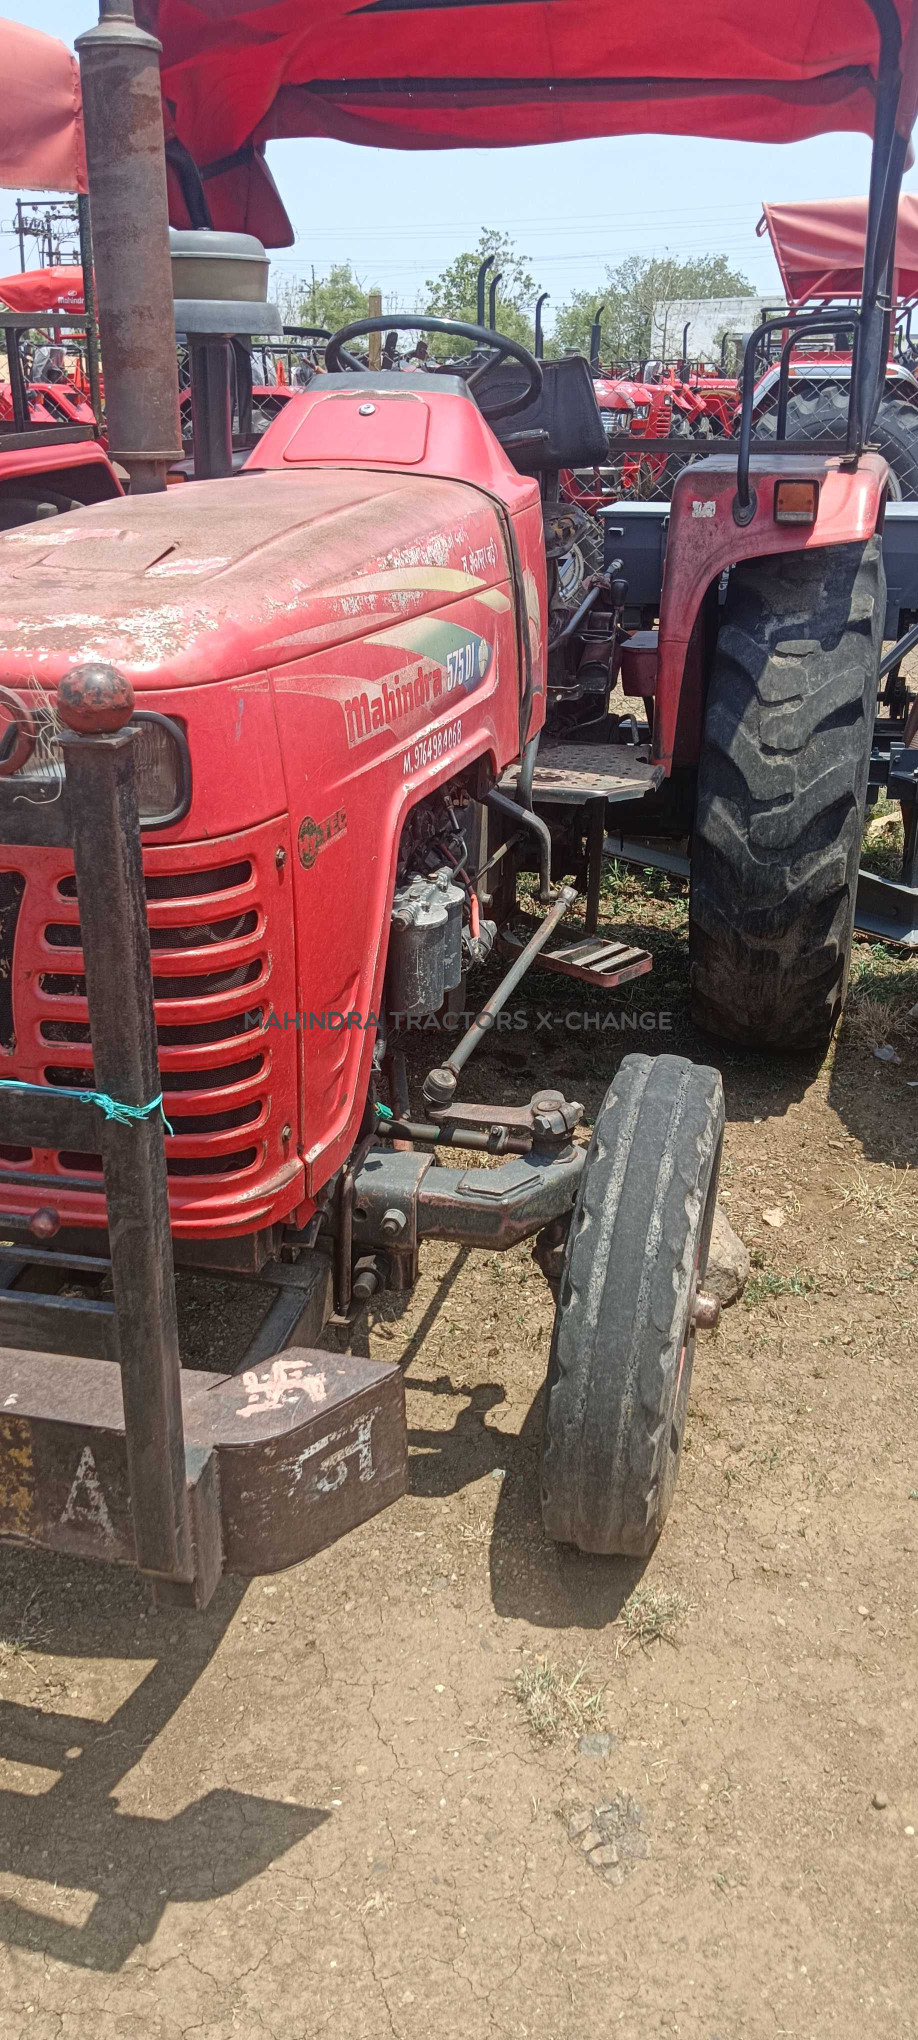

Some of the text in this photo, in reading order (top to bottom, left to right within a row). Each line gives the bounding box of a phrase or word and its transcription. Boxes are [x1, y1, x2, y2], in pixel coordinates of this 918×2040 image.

[57, 296, 85, 304] Mahindr
[344, 642, 475, 743] Mahindra 575 DI
